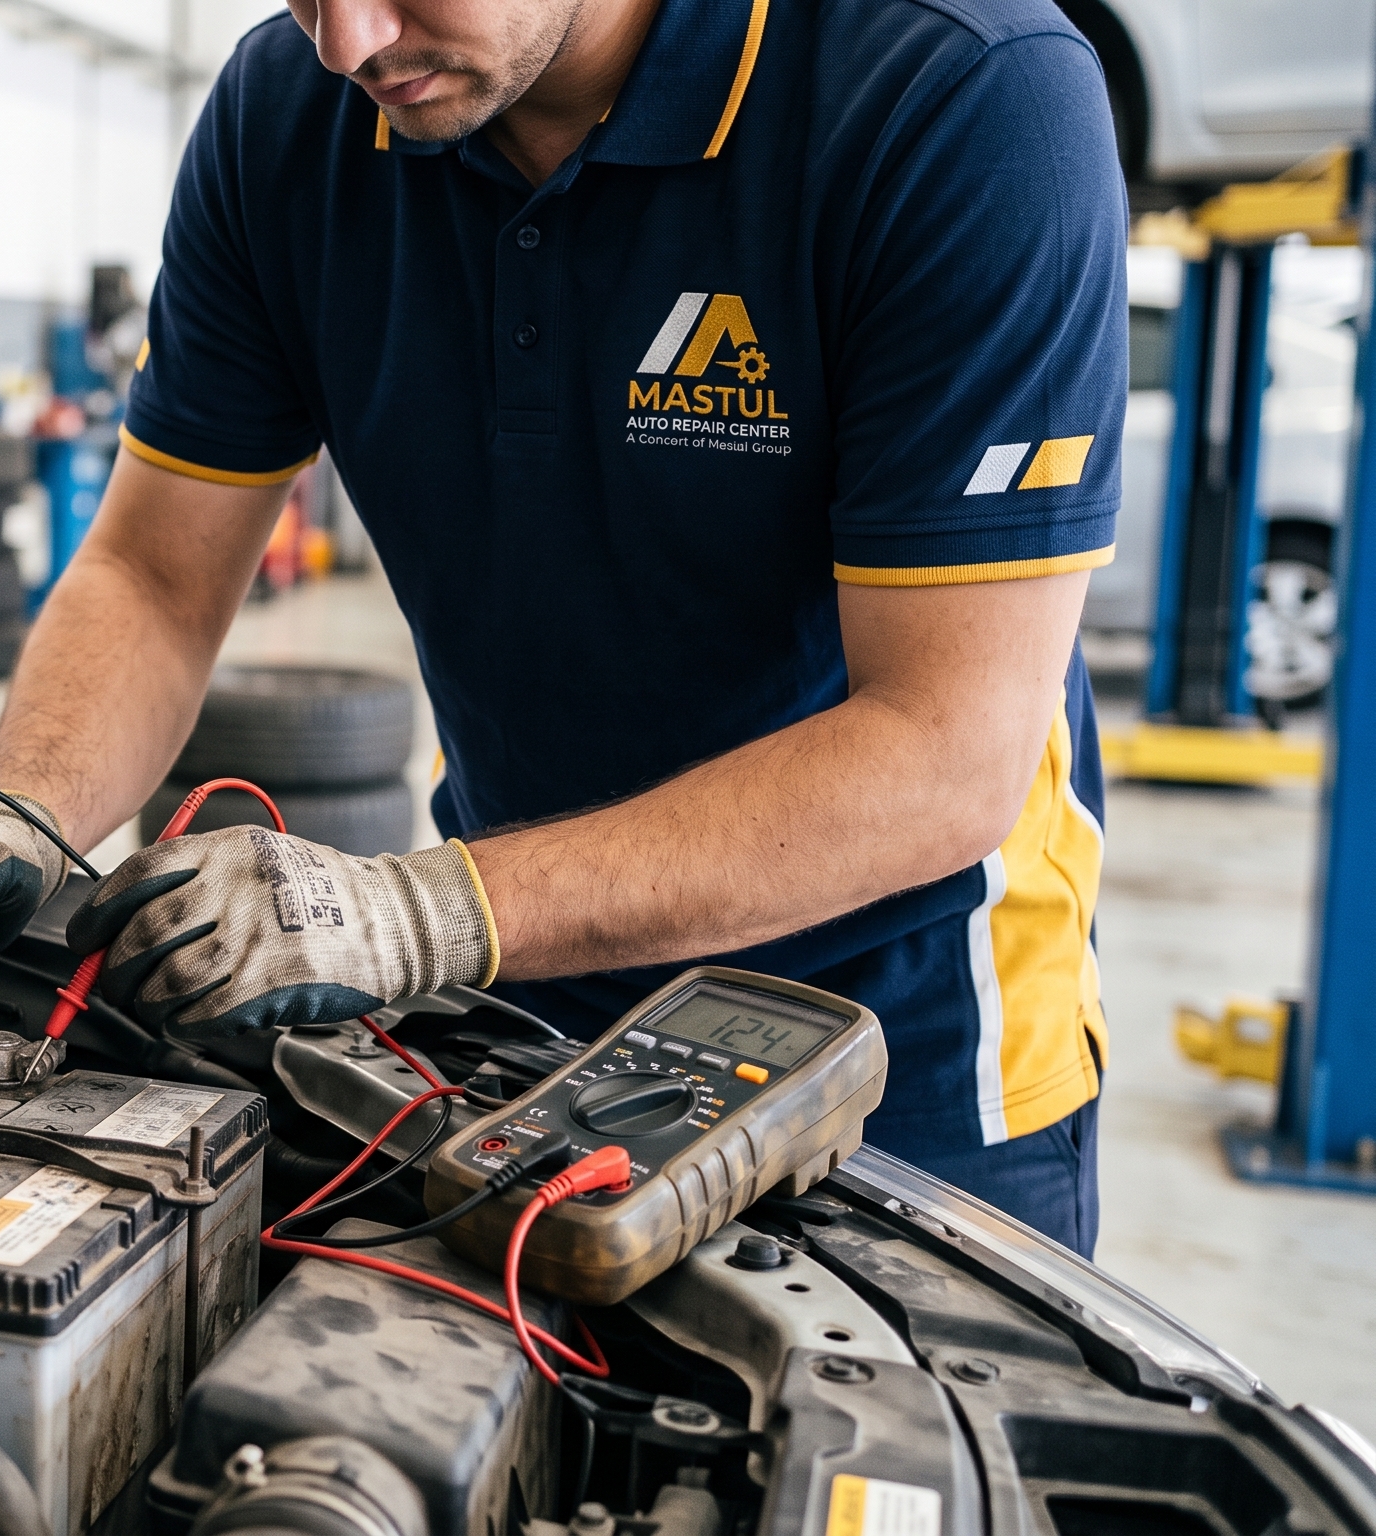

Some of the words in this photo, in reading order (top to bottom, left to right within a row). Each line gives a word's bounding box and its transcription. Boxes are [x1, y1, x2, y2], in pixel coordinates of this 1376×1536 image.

[628, 380, 789, 419] MASTUL
[626, 416, 669, 430] AUTO
[672, 418, 726, 434] REPAIR
[729, 423, 790, 439] CENTER
[626, 433, 636, 443] A
[638, 433, 689, 447] Concert
[692, 437, 706, 448] of
[752, 442, 792, 457] Group
